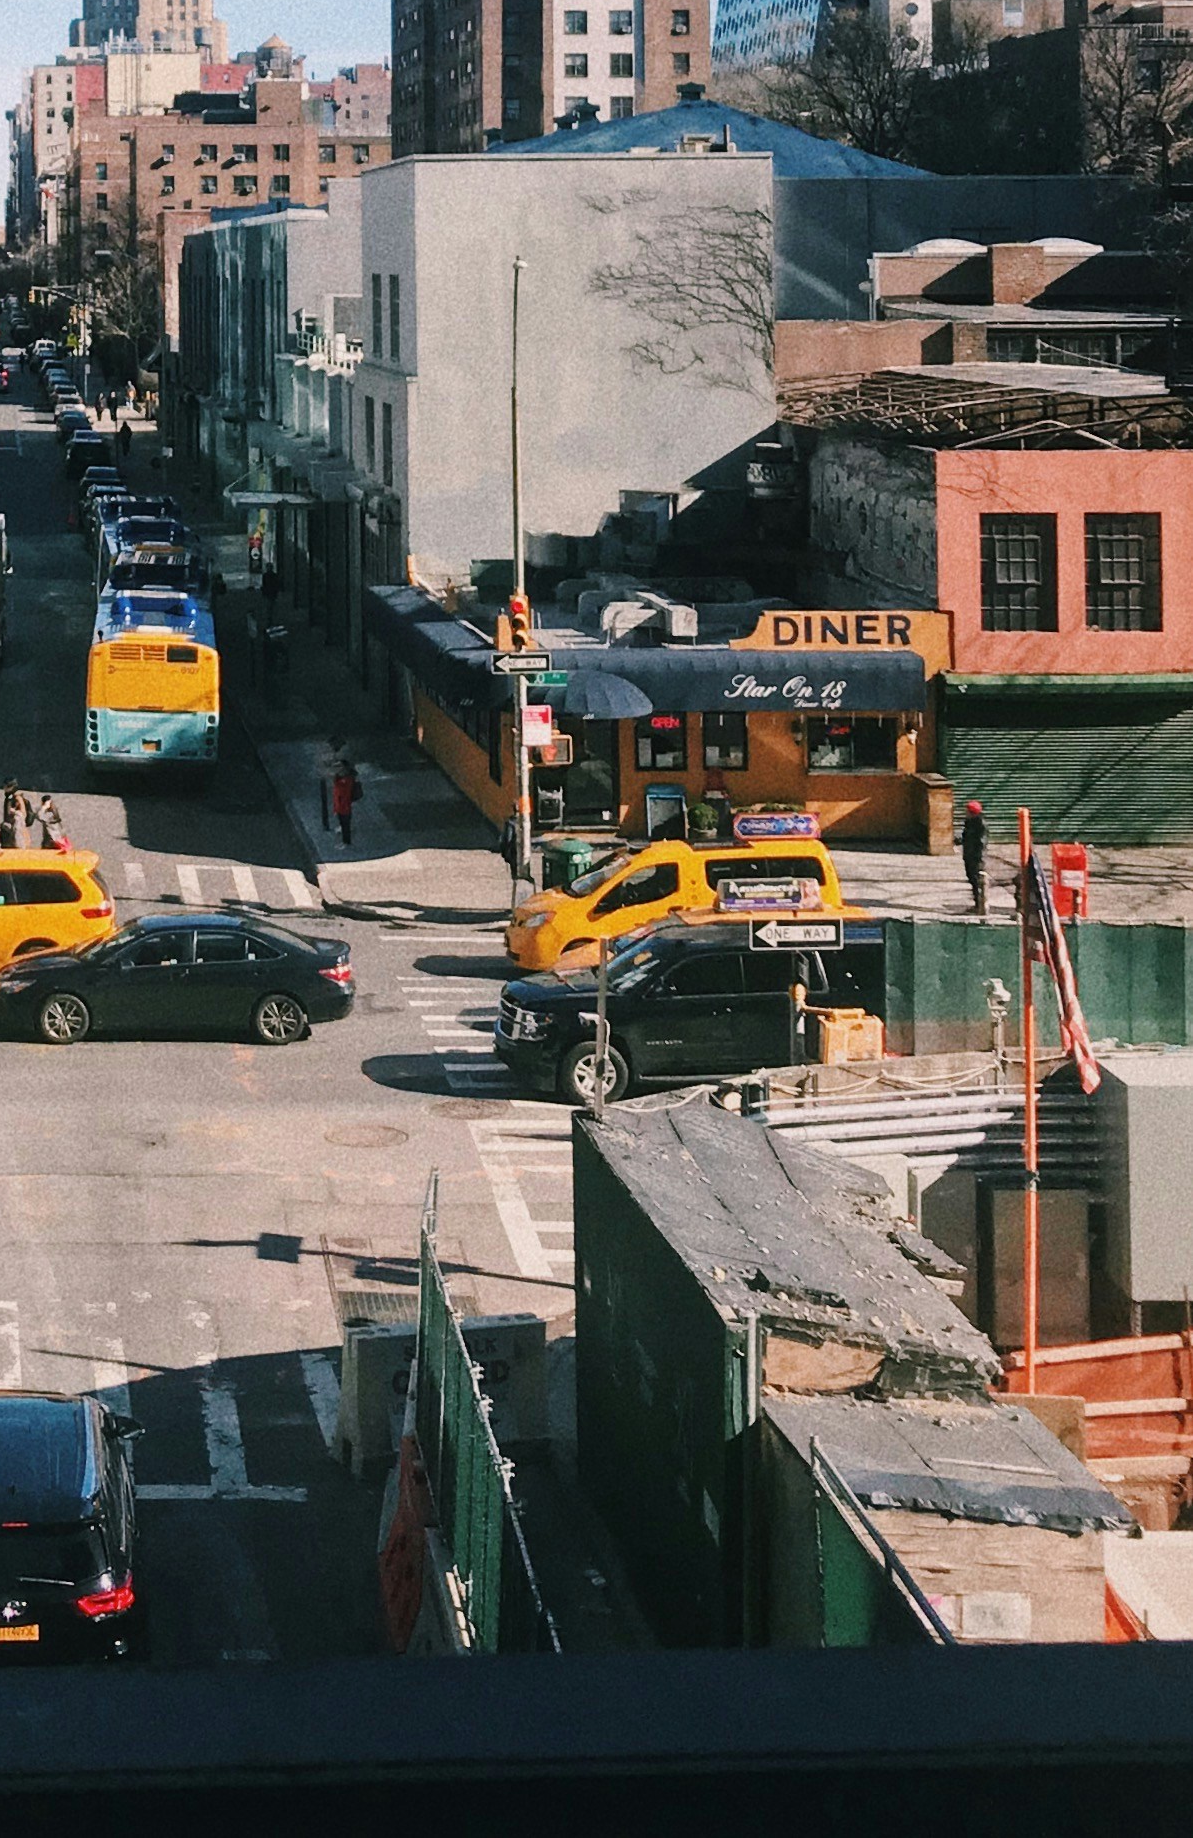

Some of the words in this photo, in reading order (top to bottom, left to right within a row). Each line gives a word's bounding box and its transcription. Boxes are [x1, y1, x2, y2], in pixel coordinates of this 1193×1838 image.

[773, 614, 911, 646] DINER
[501, 659, 517, 668] ONE
[723, 673, 778, 699] Star
[782, 674, 812, 699] On
[820, 680, 847, 699] 18
[650, 716, 681, 730] OPEN
[765, 928, 791, 939] ONE
[803, 927, 830, 939] WAY
